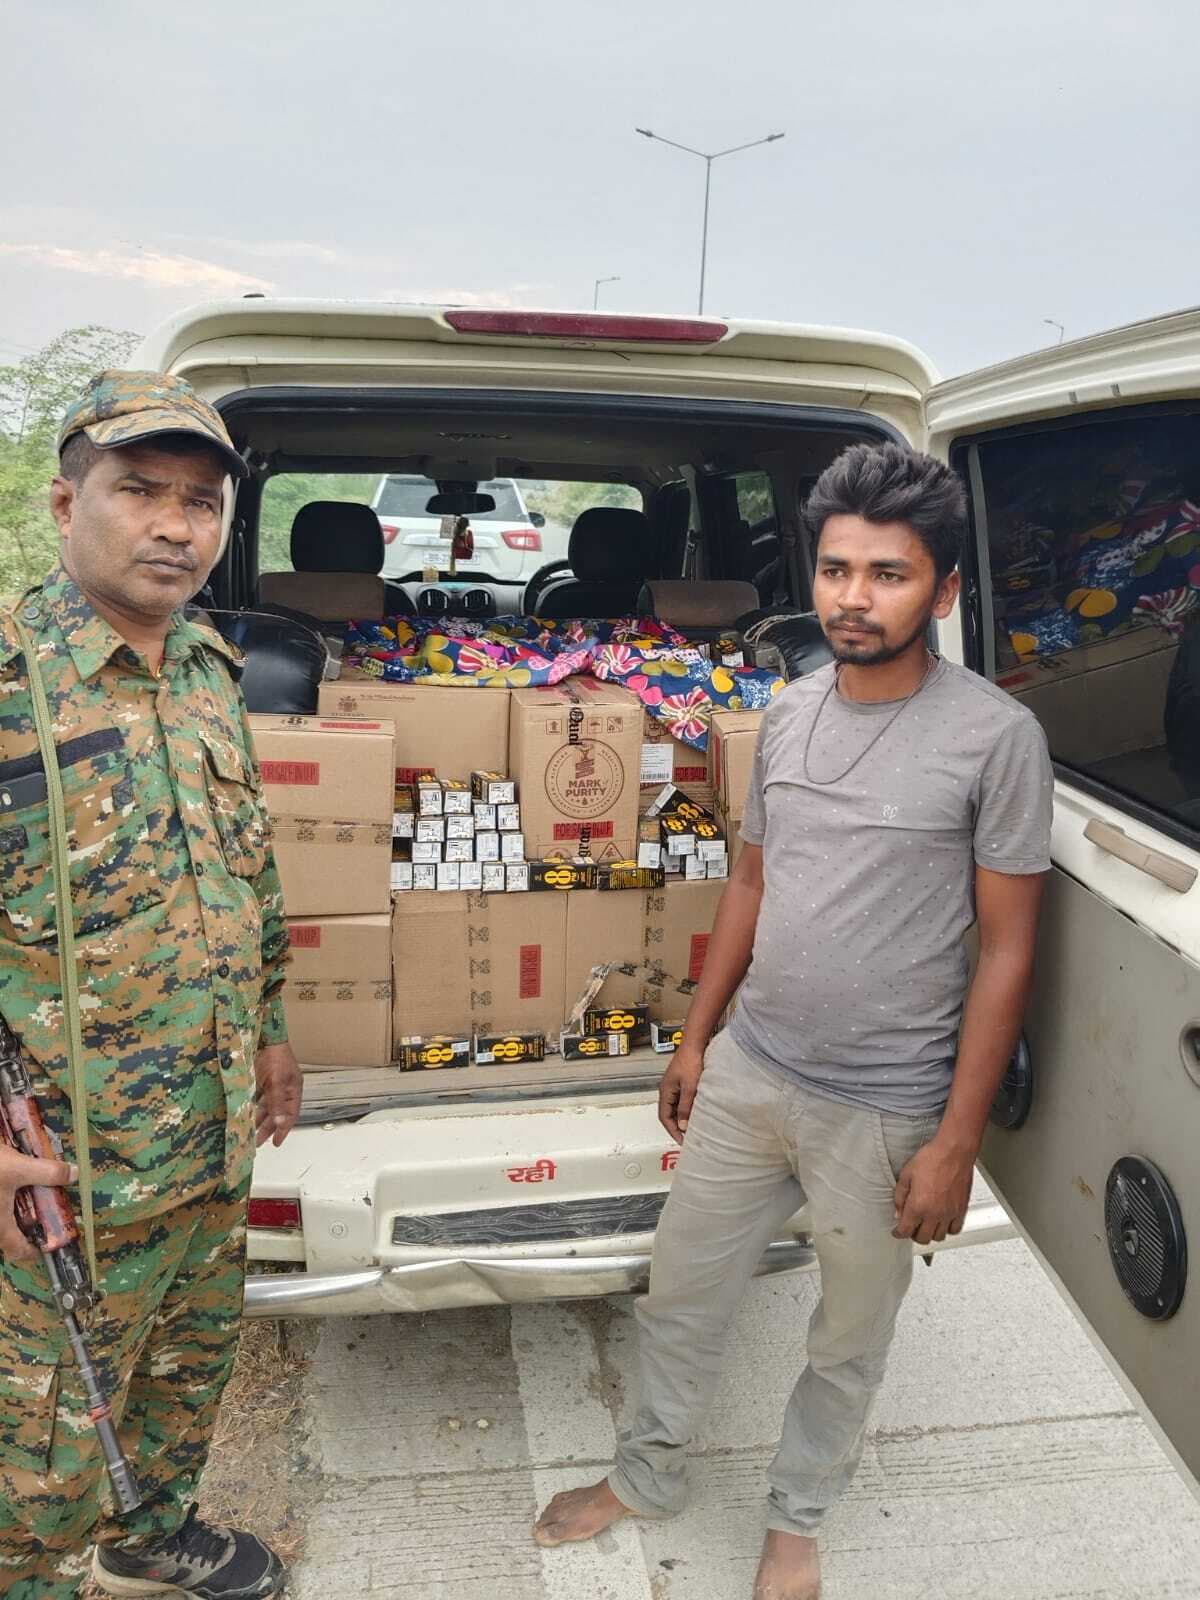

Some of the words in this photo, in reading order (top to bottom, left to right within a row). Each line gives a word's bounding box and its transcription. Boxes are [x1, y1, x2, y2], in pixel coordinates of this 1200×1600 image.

[569, 779, 601, 788] MARK
[565, 787, 607, 798] PURITY
[506, 1159, 557, 1182] रही
